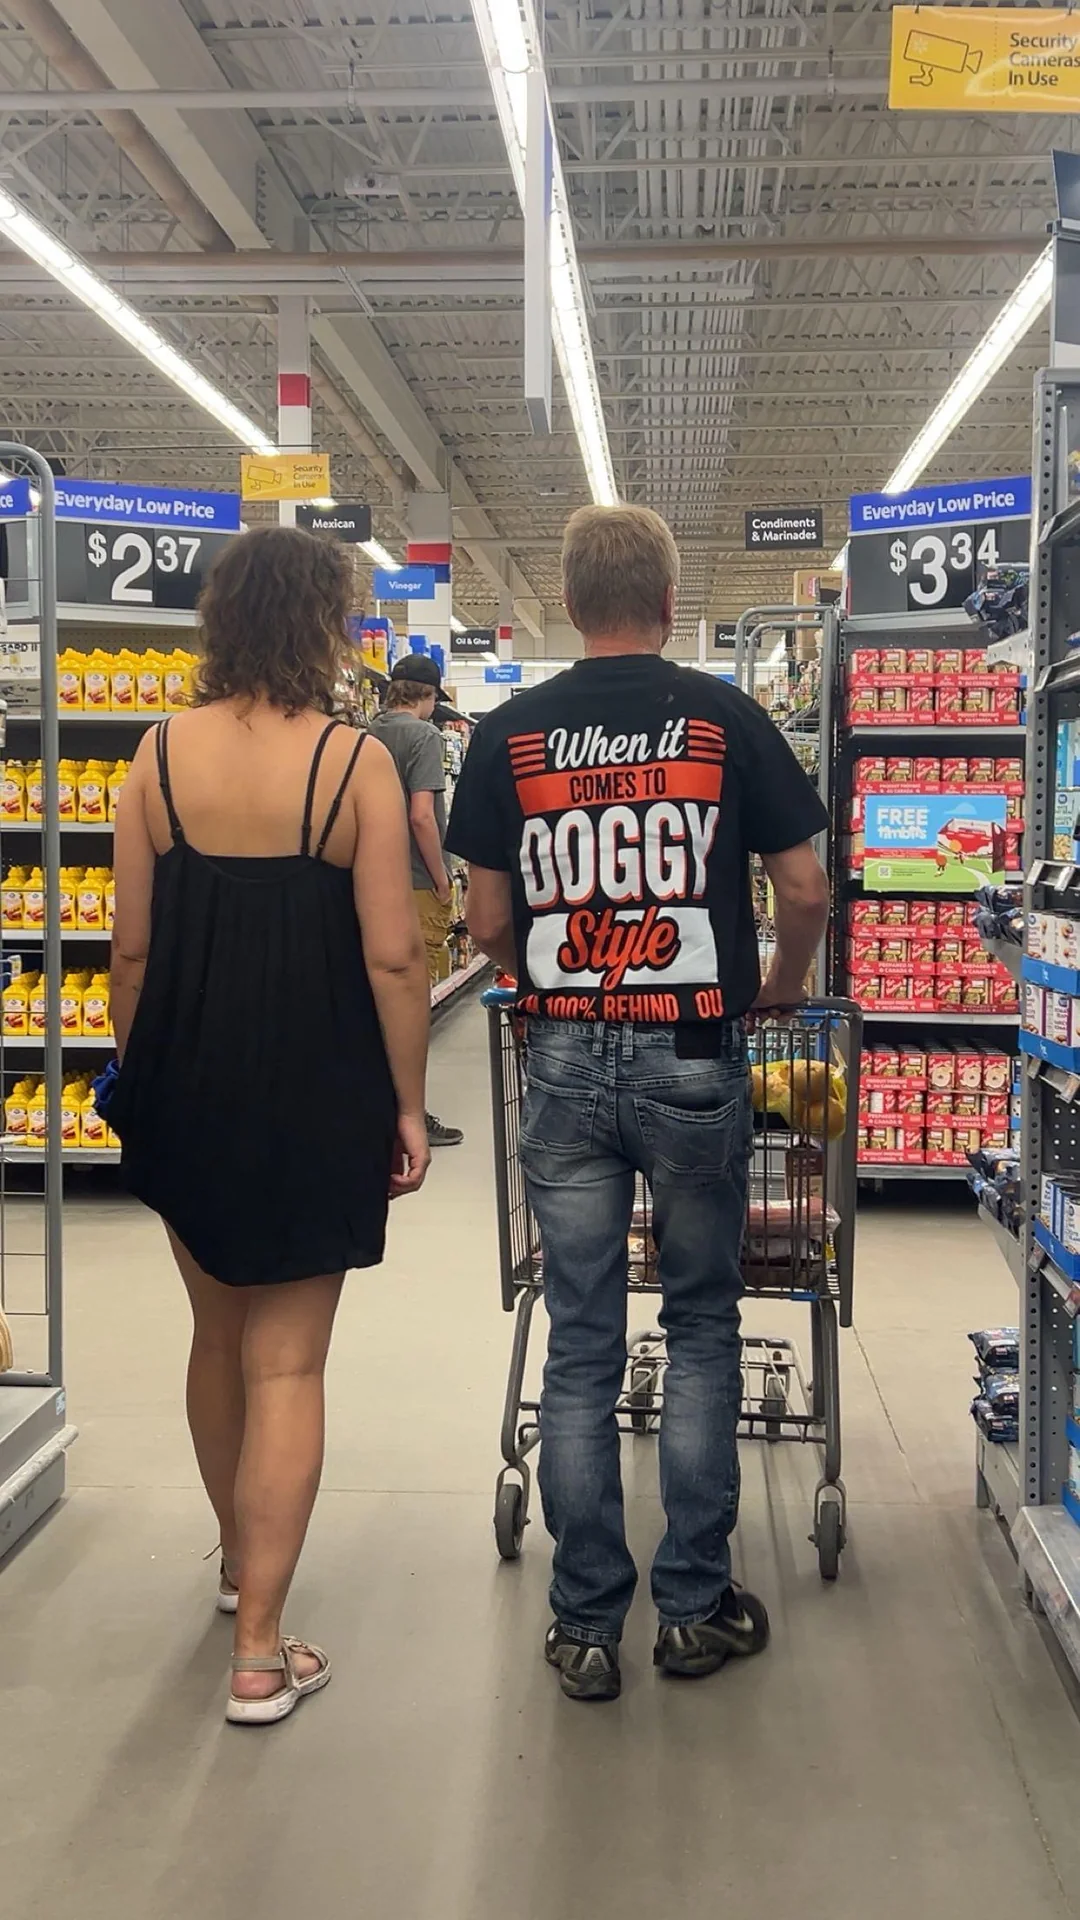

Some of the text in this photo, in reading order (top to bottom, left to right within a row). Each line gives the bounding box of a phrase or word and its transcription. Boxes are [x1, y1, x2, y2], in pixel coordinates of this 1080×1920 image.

[1009, 32, 1077, 52] Security
[1008, 52, 1080, 68] Cameras
[1008, 71, 1059, 86] In Use
[293, 464, 323, 473] Security
[293, 480, 316, 488] In Use
[55, 490, 215, 519] Everyday Low Price
[862, 491, 1015, 521] Everyday Low Price
[312, 518, 355, 529] Mexican
[752, 517, 816, 529] Condiments
[751, 529, 817, 541] & Marinades
[388, 580, 422, 592] Vinegar
[455, 637, 490, 645] Oil & Ghee
[547, 716, 686, 770] When it
[569, 766, 666, 804] COMES TO
[877, 808, 928, 826] FREE
[519, 801, 720, 910] DOGGY
[559, 905, 679, 991] Style
[545, 994, 597, 1020] 100%
[602, 992, 680, 1023] BEHIND
[694, 988, 724, 1019] OU
